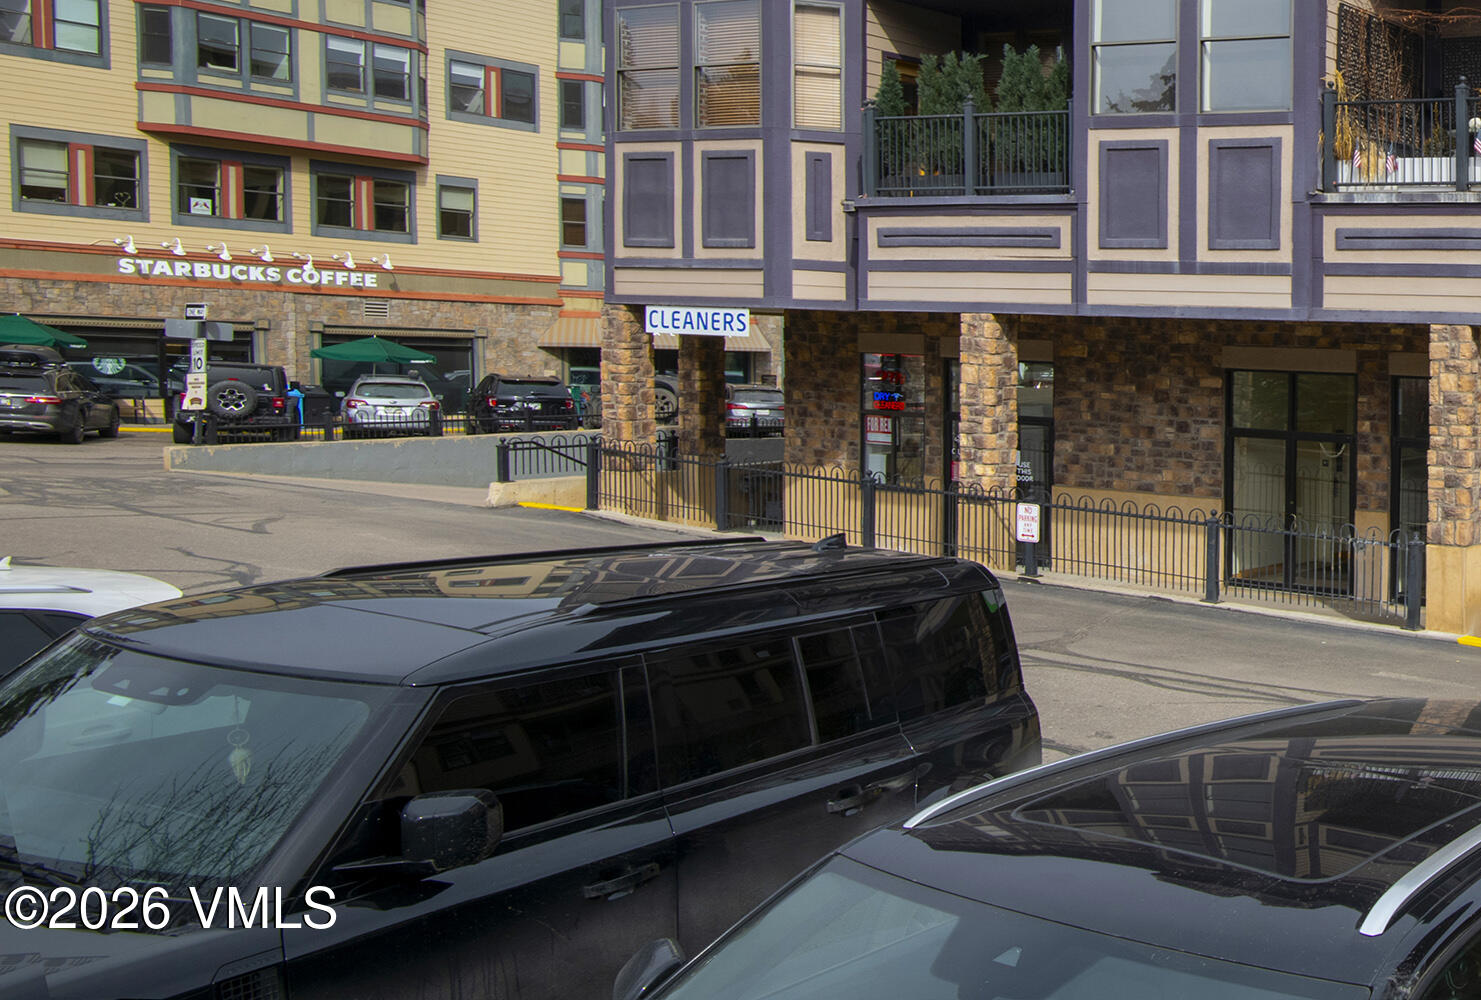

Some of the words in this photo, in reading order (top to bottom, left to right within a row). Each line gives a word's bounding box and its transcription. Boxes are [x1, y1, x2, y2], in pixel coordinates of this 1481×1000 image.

[117, 257, 282, 283] STARBUCKS
[286, 266, 378, 288] COFFEE
[649, 309, 747, 332] CLEANERS
[193, 356, 204, 370] 10
[873, 391, 891, 401] DRY
[873, 400, 905, 411] CLEANERS
[867, 416, 879, 432] FOR
[1024, 506, 1032, 514] NO
[1019, 514, 1038, 523] PARKING
